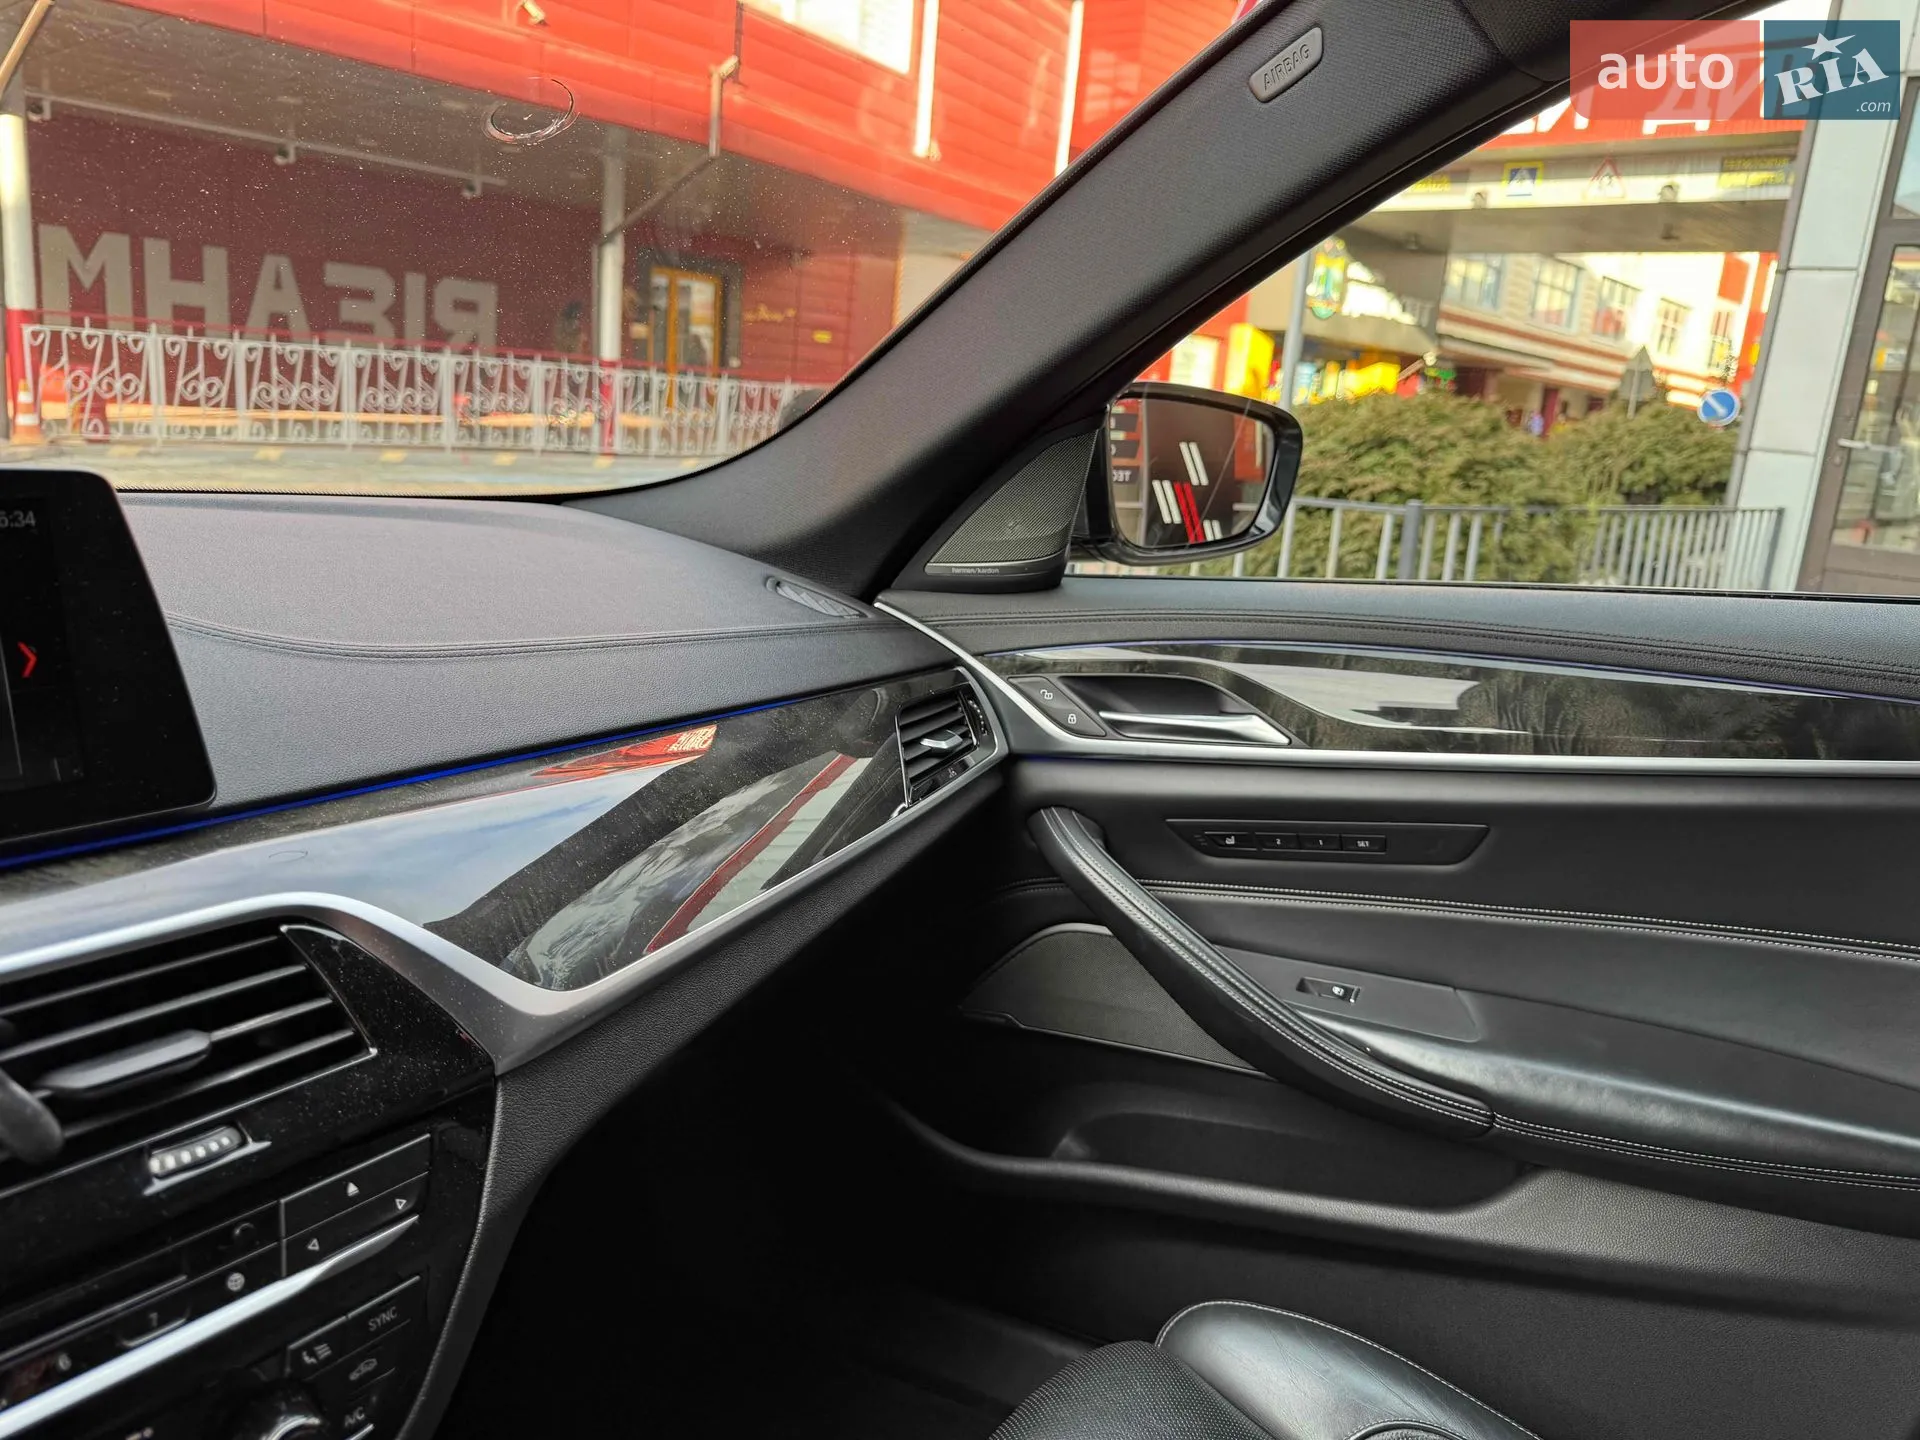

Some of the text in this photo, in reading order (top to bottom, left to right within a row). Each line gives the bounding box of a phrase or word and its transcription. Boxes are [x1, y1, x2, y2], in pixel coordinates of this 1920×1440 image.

[1263, 43, 1310, 92] AIRBAG
[148, 1312, 158, 1327] 1
[368, 1306, 398, 1332] SYNC
[344, 1406, 365, 1428] A/C
